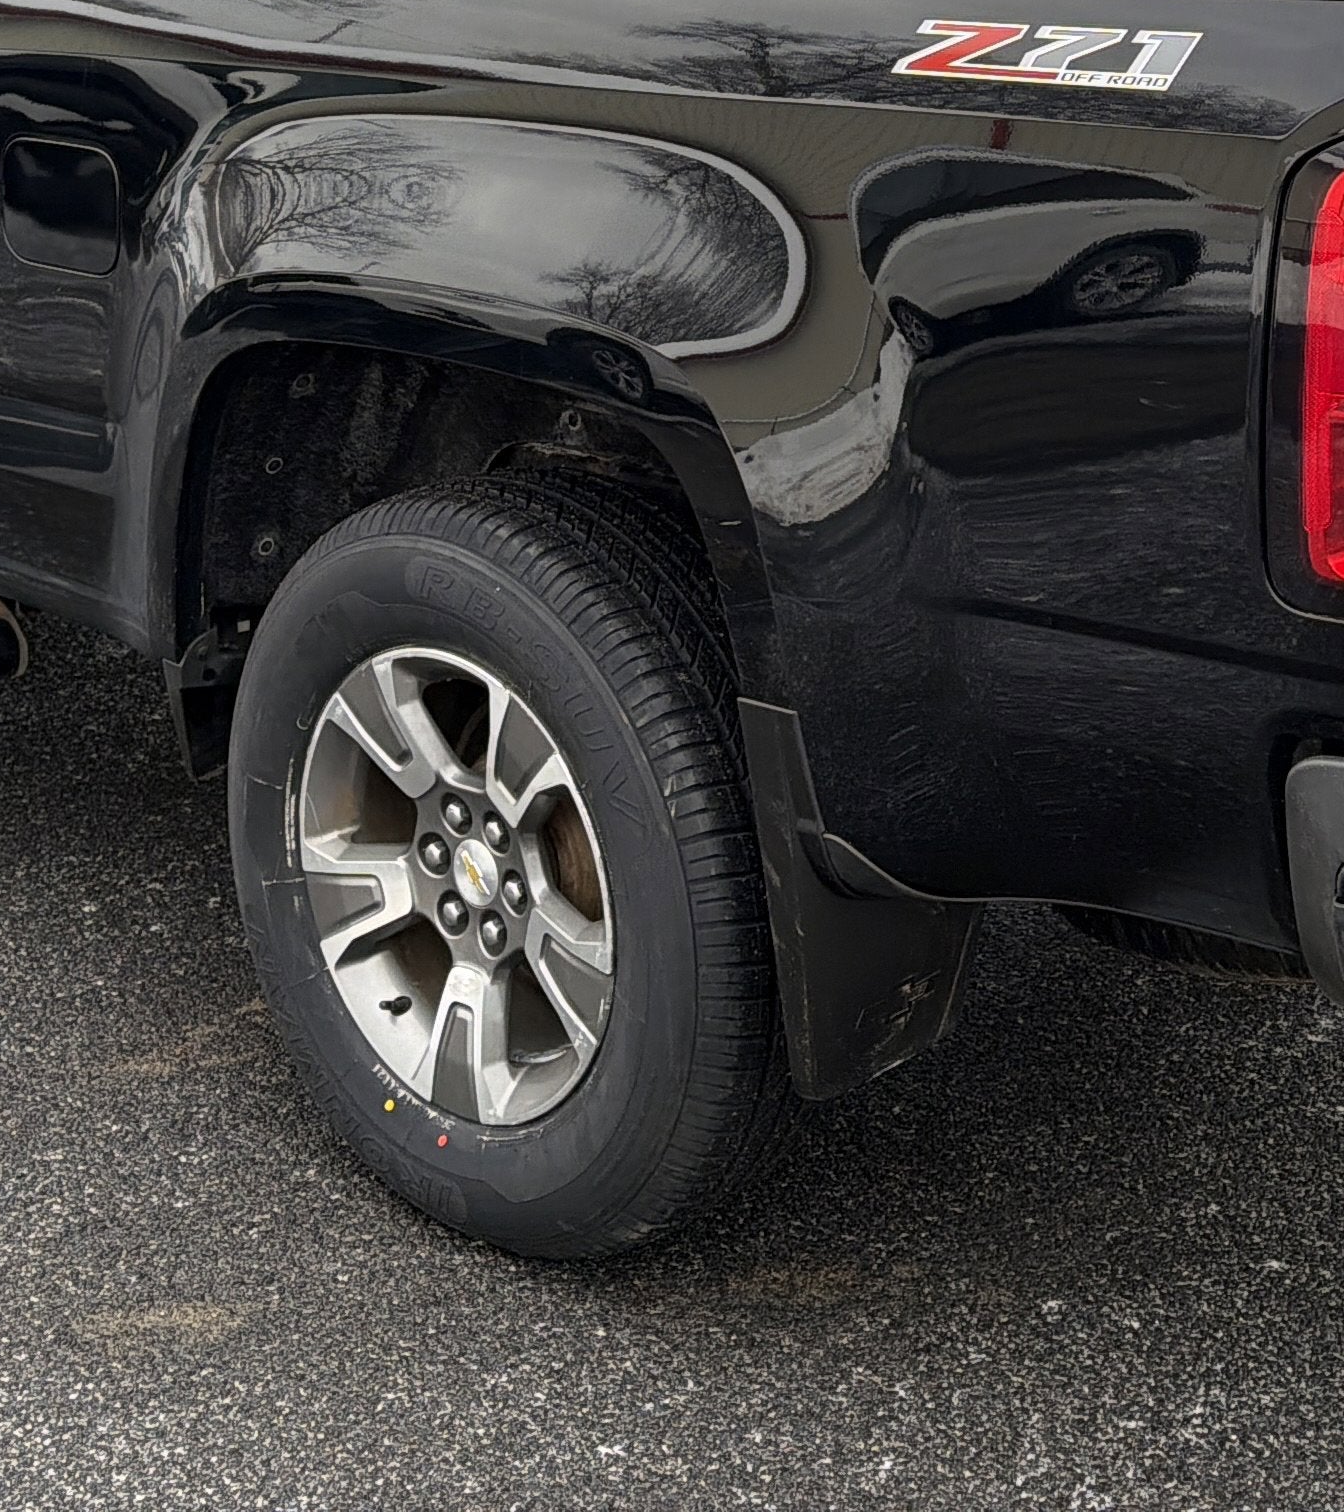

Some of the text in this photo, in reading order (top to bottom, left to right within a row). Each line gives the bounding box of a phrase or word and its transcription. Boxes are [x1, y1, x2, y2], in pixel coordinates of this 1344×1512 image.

[891, 19, 1204, 82] Z71
[1060, 72, 1169, 89] OFF ROAD
